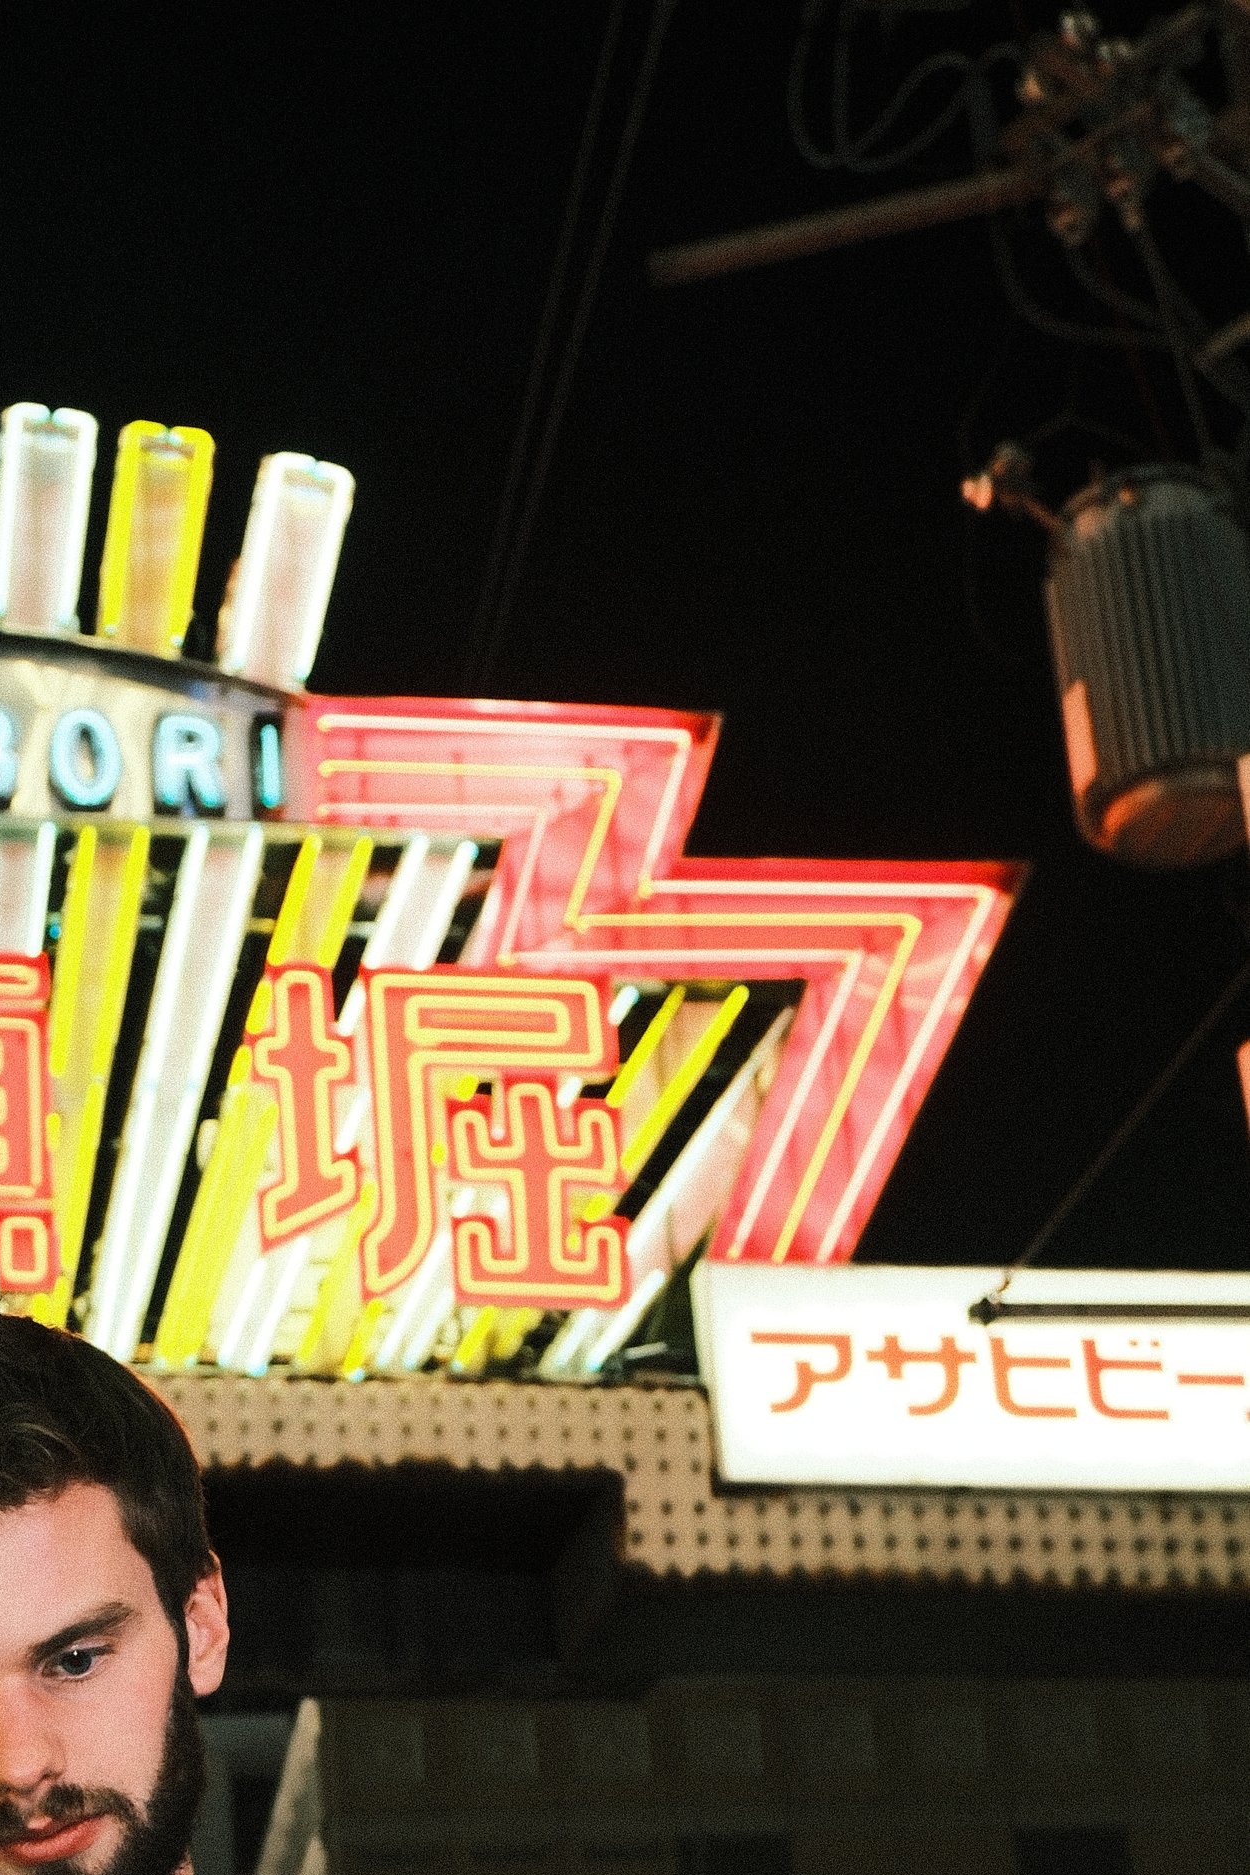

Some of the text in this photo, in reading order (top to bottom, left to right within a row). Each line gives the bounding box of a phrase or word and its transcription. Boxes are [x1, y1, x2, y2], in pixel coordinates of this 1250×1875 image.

[751, 1331, 1250, 1421] アサヒビー
